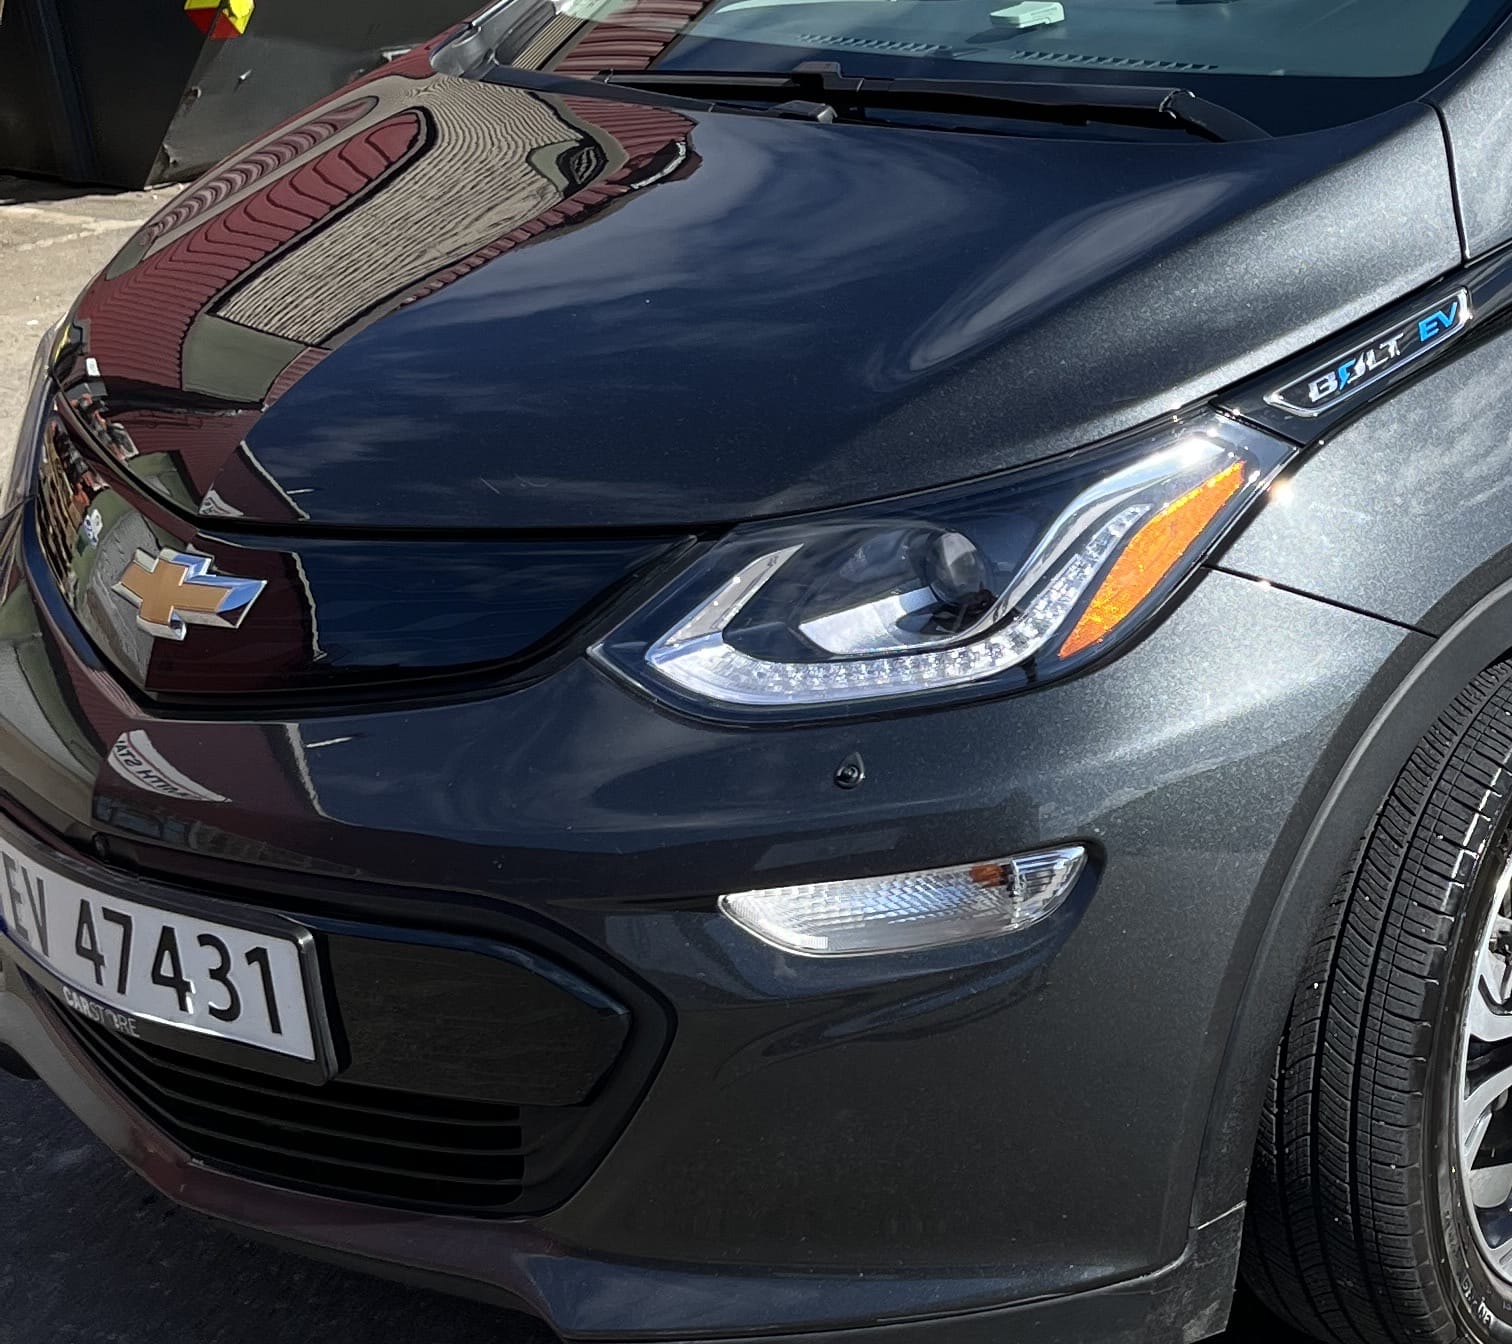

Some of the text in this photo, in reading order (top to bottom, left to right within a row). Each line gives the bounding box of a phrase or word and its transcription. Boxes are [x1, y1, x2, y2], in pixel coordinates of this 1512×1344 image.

[1307, 301, 1459, 403] BOLT EV
[1, 851, 283, 1036] EV 47431
[62, 985, 141, 1039] CARSTORE
